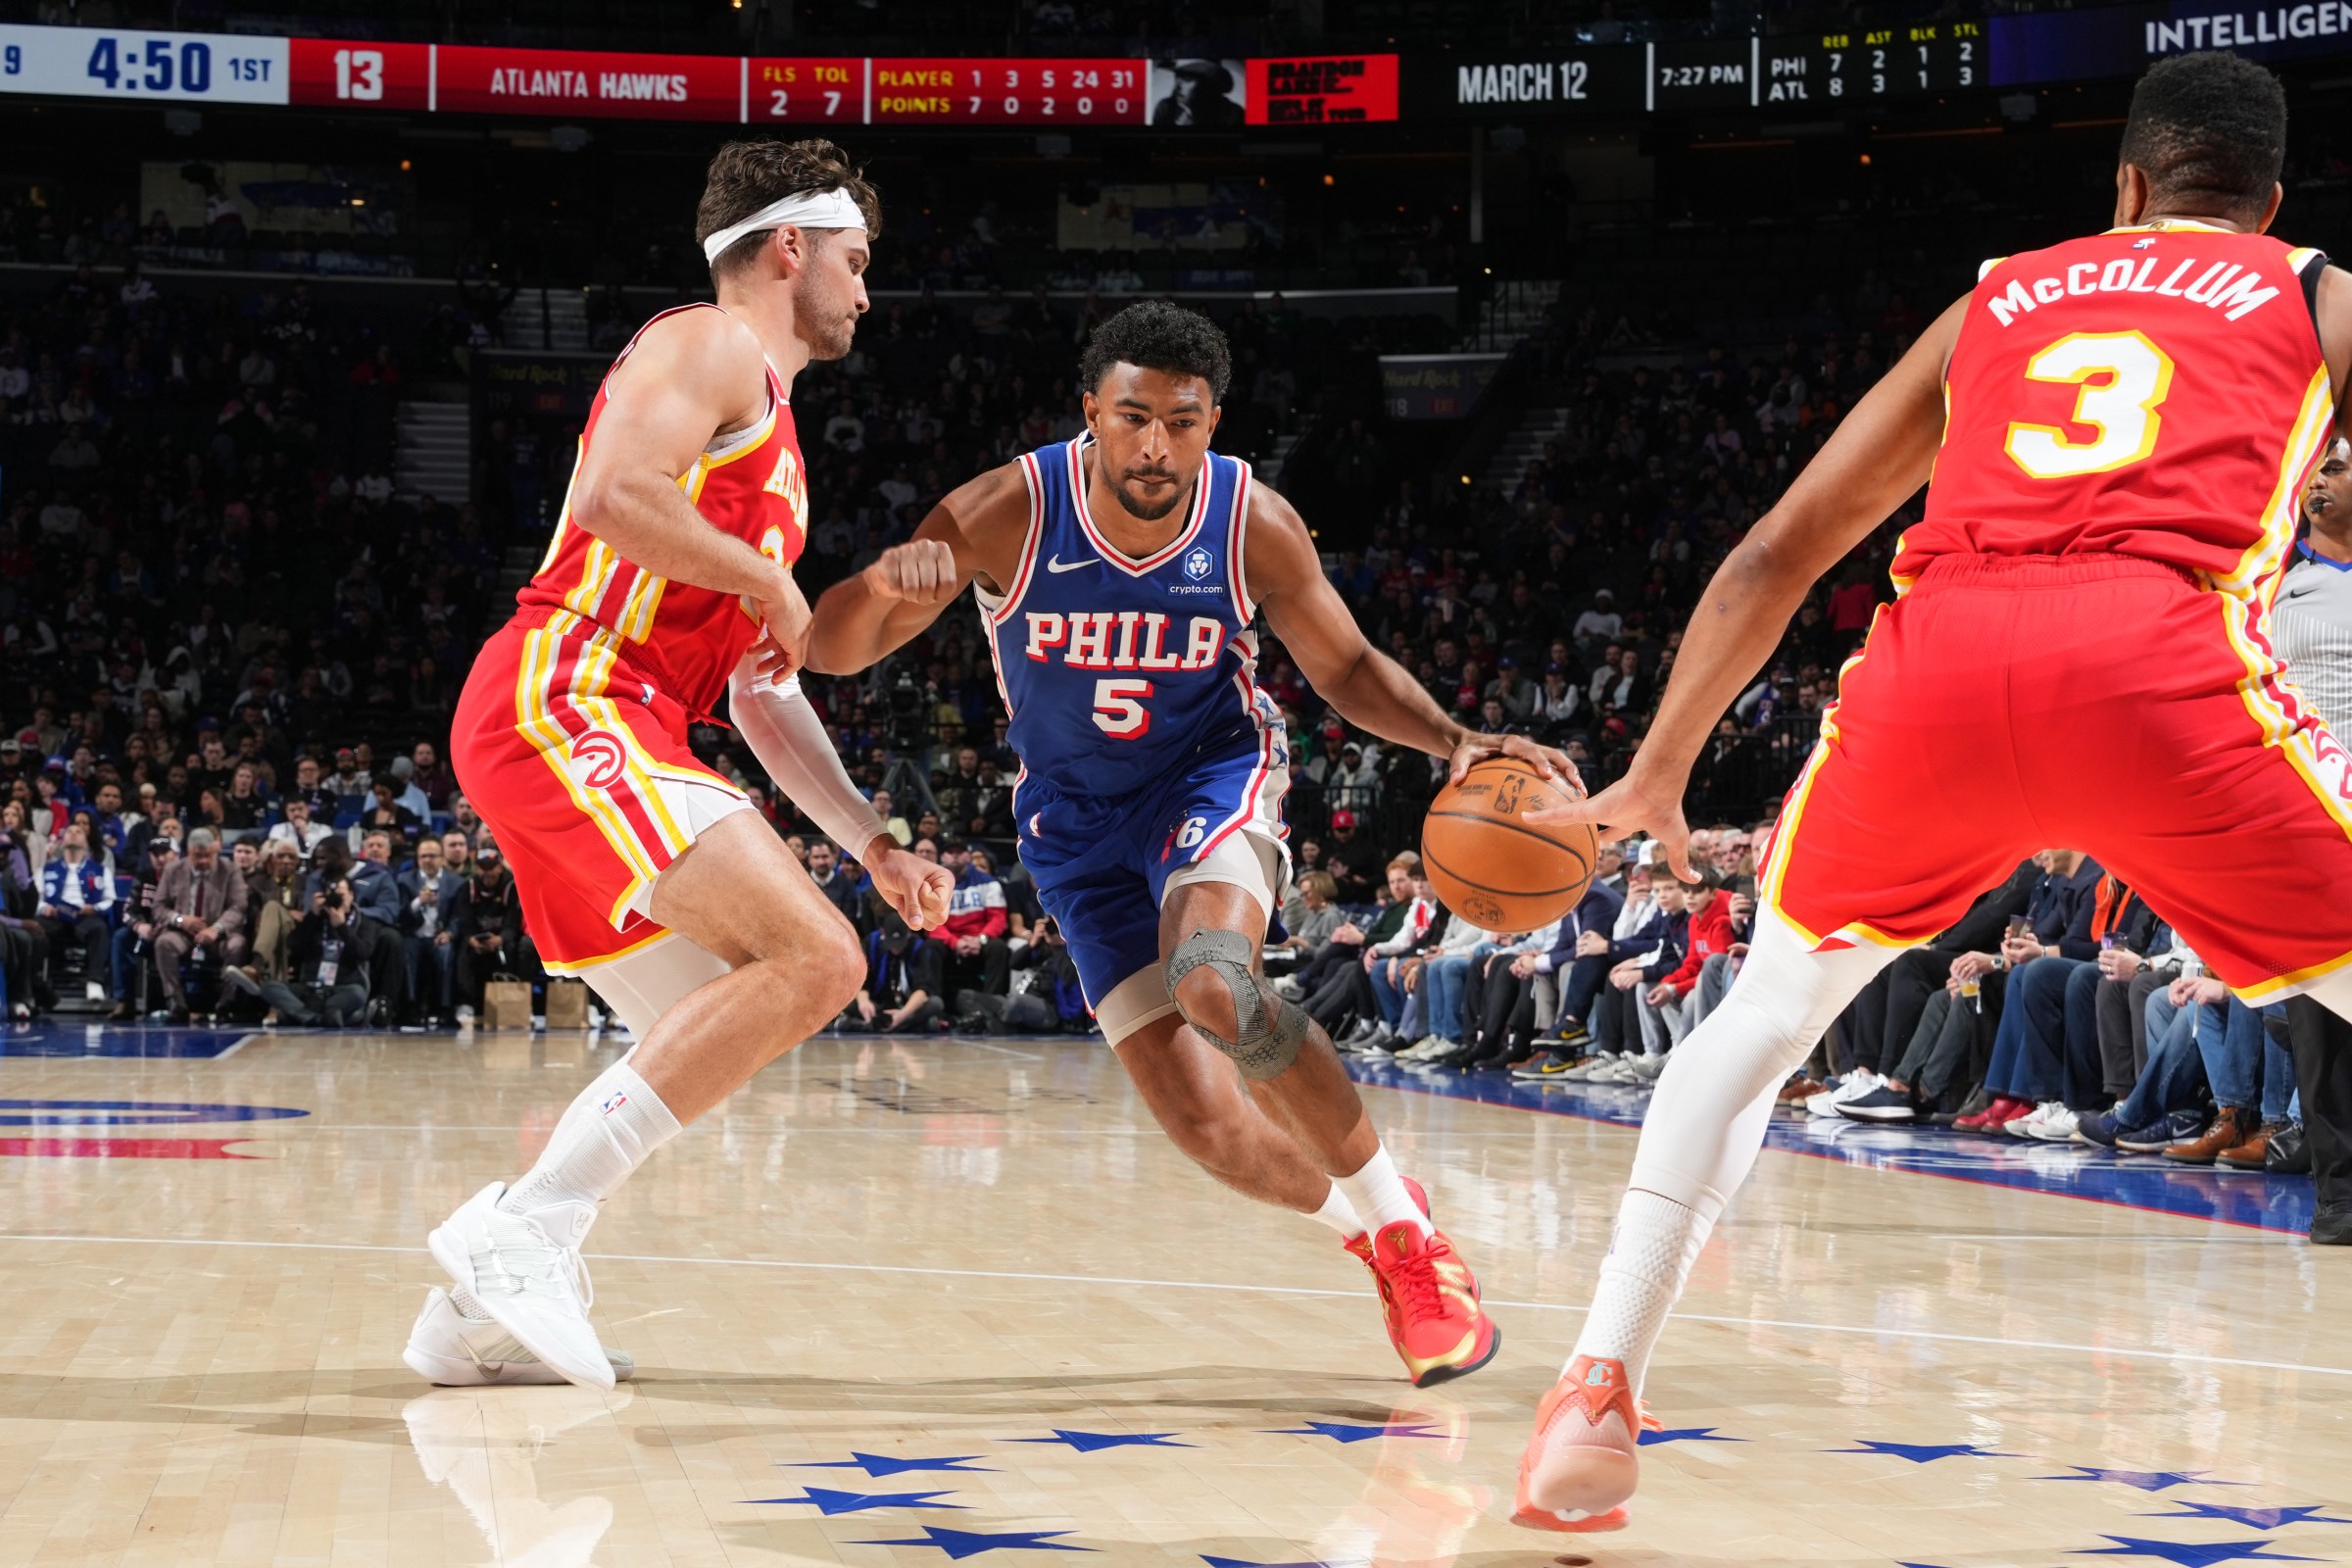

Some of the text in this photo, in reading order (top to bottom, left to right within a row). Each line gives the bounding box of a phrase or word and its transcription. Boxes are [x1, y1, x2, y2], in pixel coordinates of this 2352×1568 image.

[1823, 24, 1979, 48] REB AST BLK STL
[2145, 1, 2352, 53] INTELLIGEN
[5, 45, 21, 74] 9
[87, 38, 271, 92] 4:50 1ST
[334, 50, 383, 100] 13
[763, 66, 849, 82] FLS TOL
[1661, 65, 1743, 85] 7:27 PM
[1771, 42, 1972, 76] PHI 7 2 1 2
[492, 68, 688, 101] ATLANTA HAWKS
[879, 70, 1134, 87] PLAYER 1 3 5 24 31
[1458, 61, 1588, 103] MARCH 12
[1768, 67, 1972, 101] ATL 8 3 1 3
[770, 90, 841, 116] 2 7
[881, 97, 1128, 115] POINTS 7 0 2 0 0
[1987, 257, 2280, 327] McCOLLUM
[2004, 329, 2175, 478] 3
[1169, 584, 1223, 595] crypto.com
[1025, 612, 1225, 672] PHILA
[1092, 679, 1153, 740] 5
